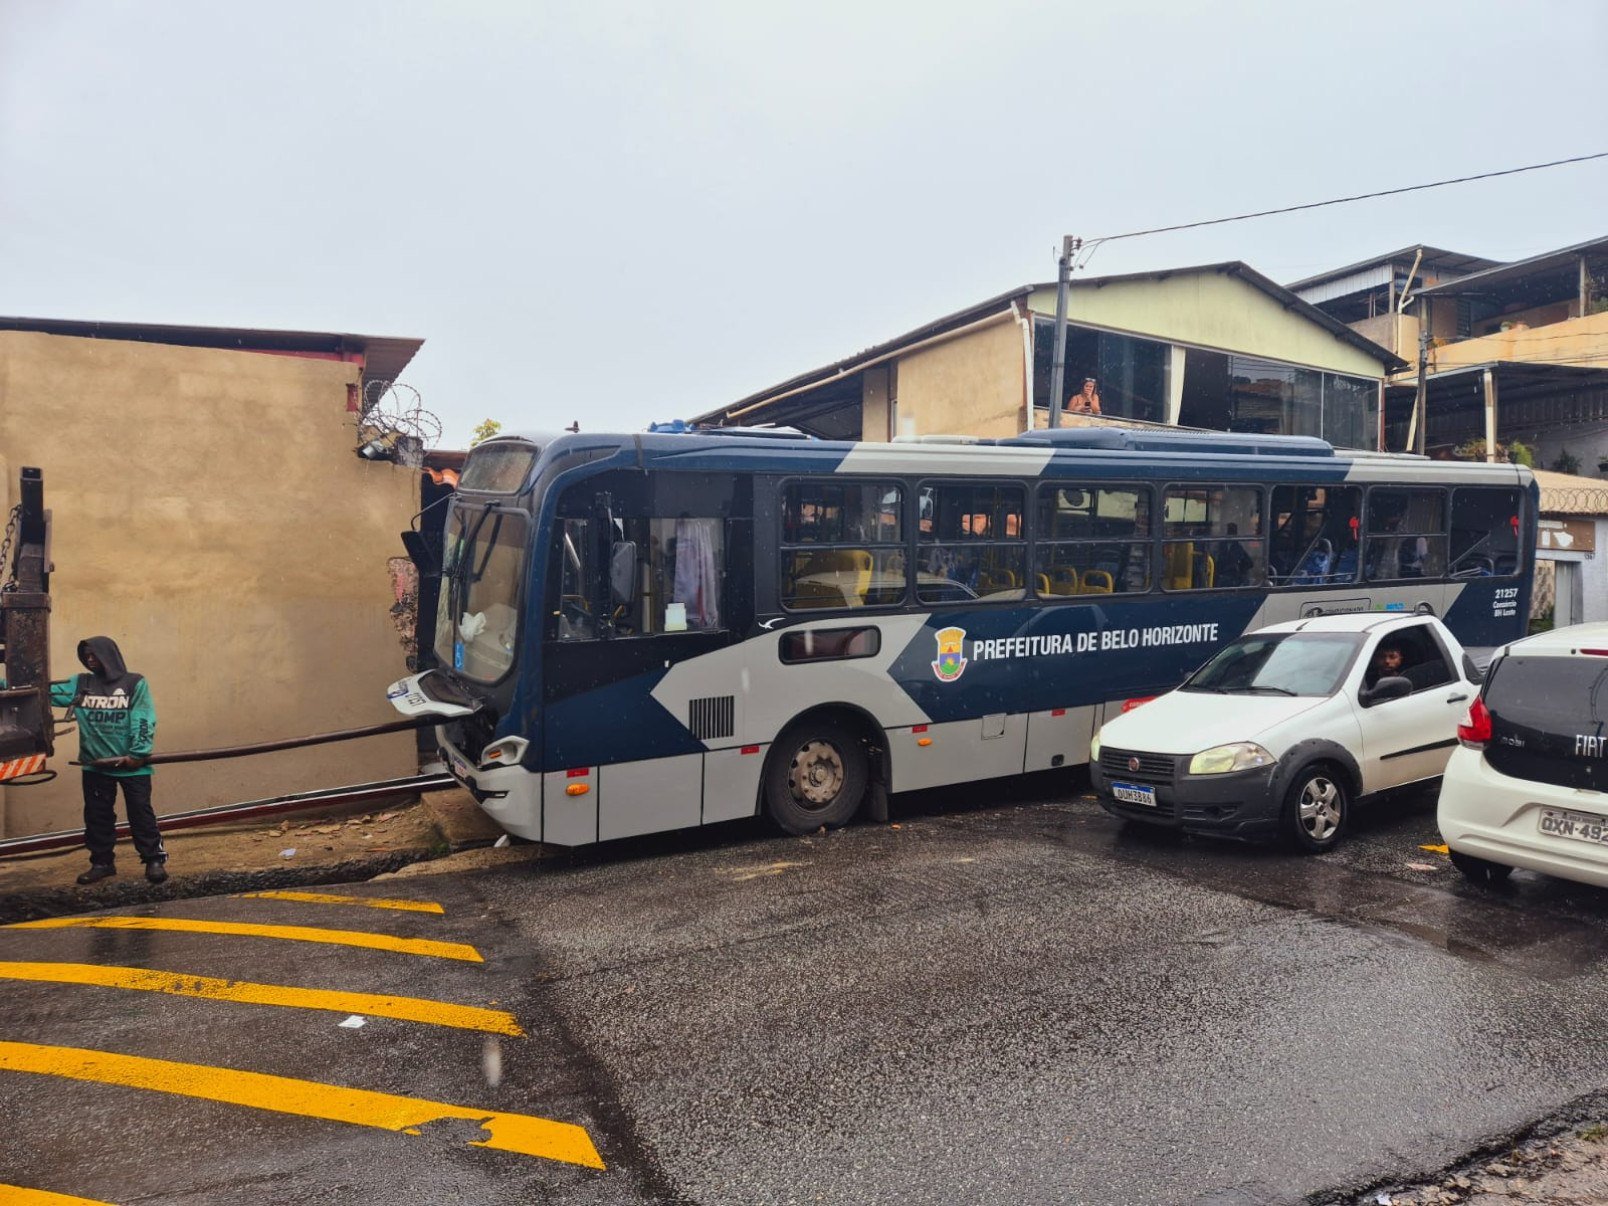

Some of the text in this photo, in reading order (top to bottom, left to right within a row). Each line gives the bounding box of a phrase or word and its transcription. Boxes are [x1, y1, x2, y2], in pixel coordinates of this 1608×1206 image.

[1495, 588, 1519, 599] 21257
[973, 623, 1219, 661] PREFEITURA DE BELO HORIZONTE
[87, 711, 126, 724] COMP
[1575, 734, 1607, 758] FIAT
